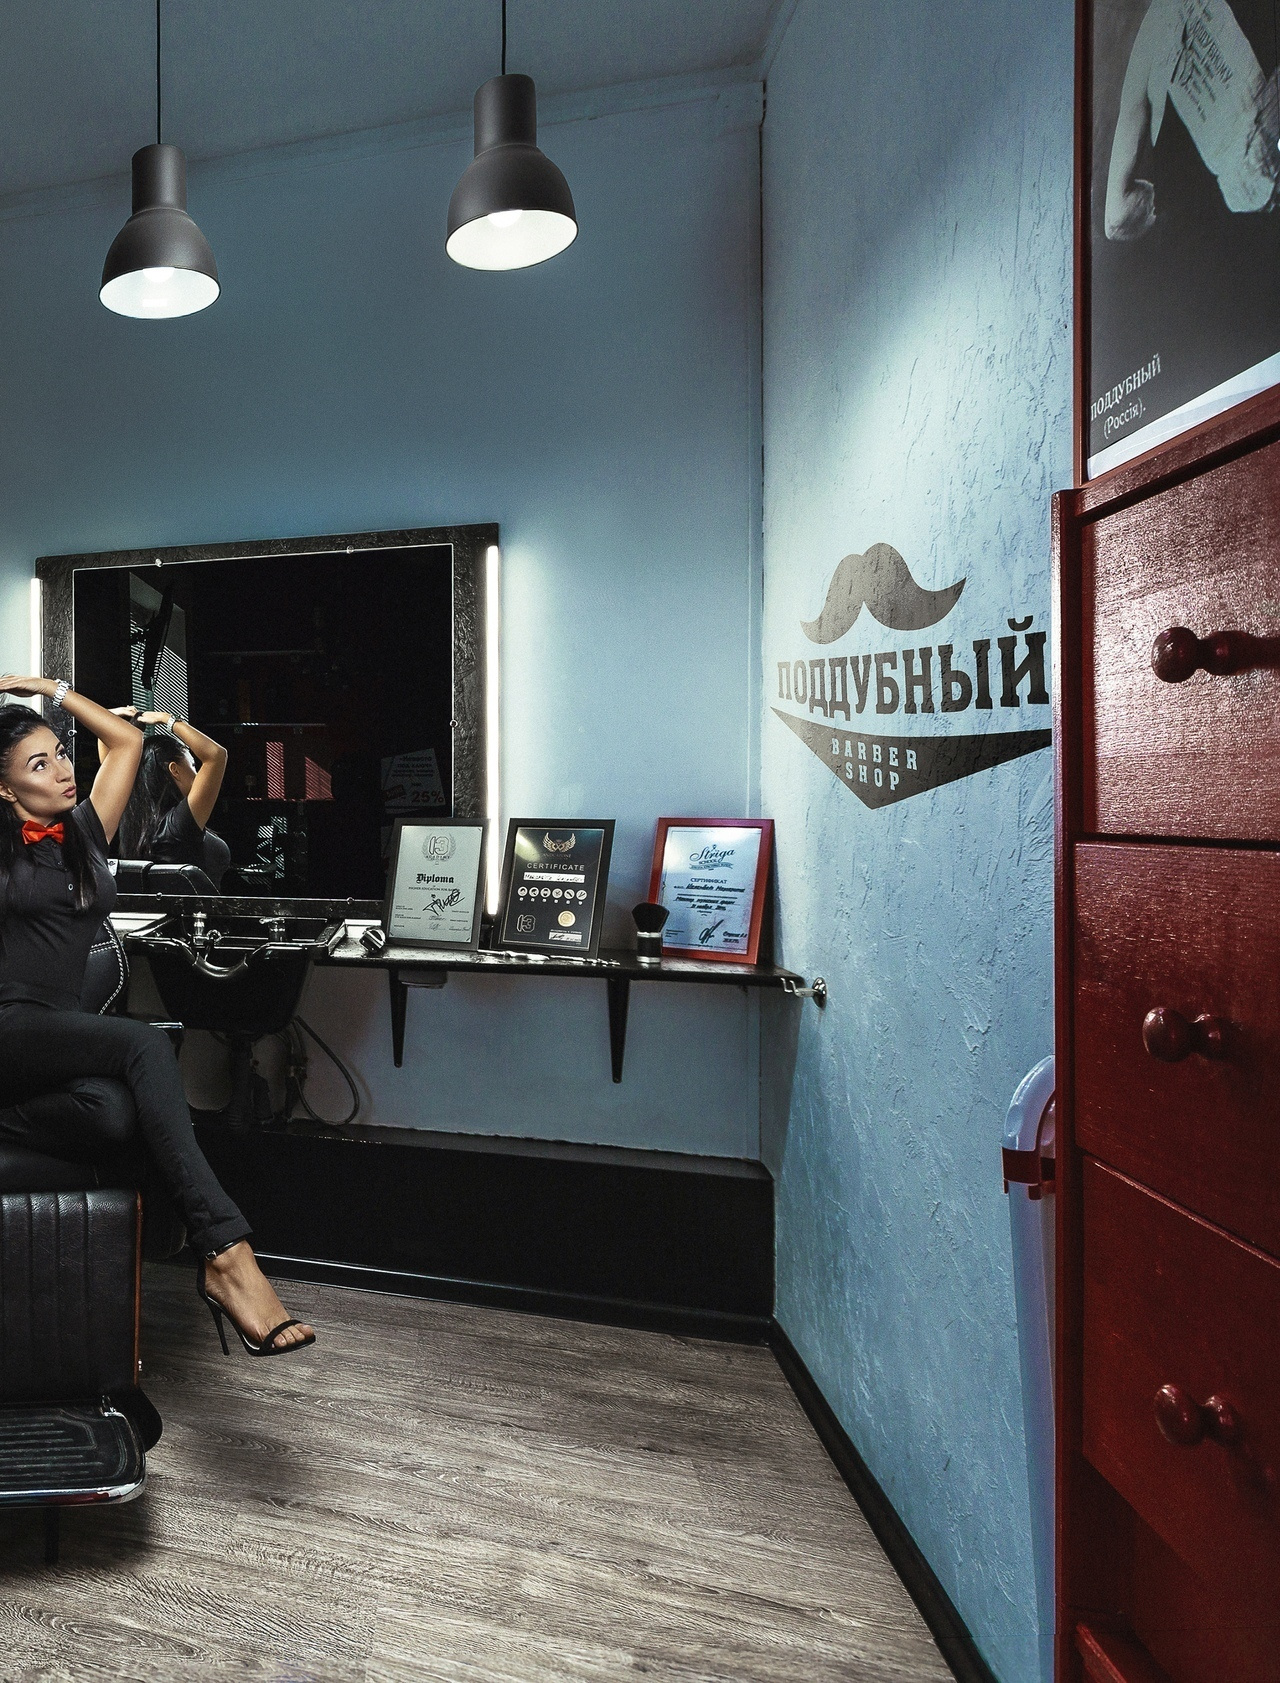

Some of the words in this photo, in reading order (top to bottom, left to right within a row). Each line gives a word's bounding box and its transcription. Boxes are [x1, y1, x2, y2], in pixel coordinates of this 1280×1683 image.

[1091, 352, 1161, 422] ПОДДУБНЫЙ
[777, 615, 1050, 721] ПОДДУБНЫЙ
[831, 737, 918, 771] BARBER
[845, 761, 900, 791] SHOP
[411, 790, 444, 803] 25%
[689, 846, 735, 862] Striga
[526, 862, 585, 872] CERTIFICATE
[416, 873, 455, 885] Diploma
